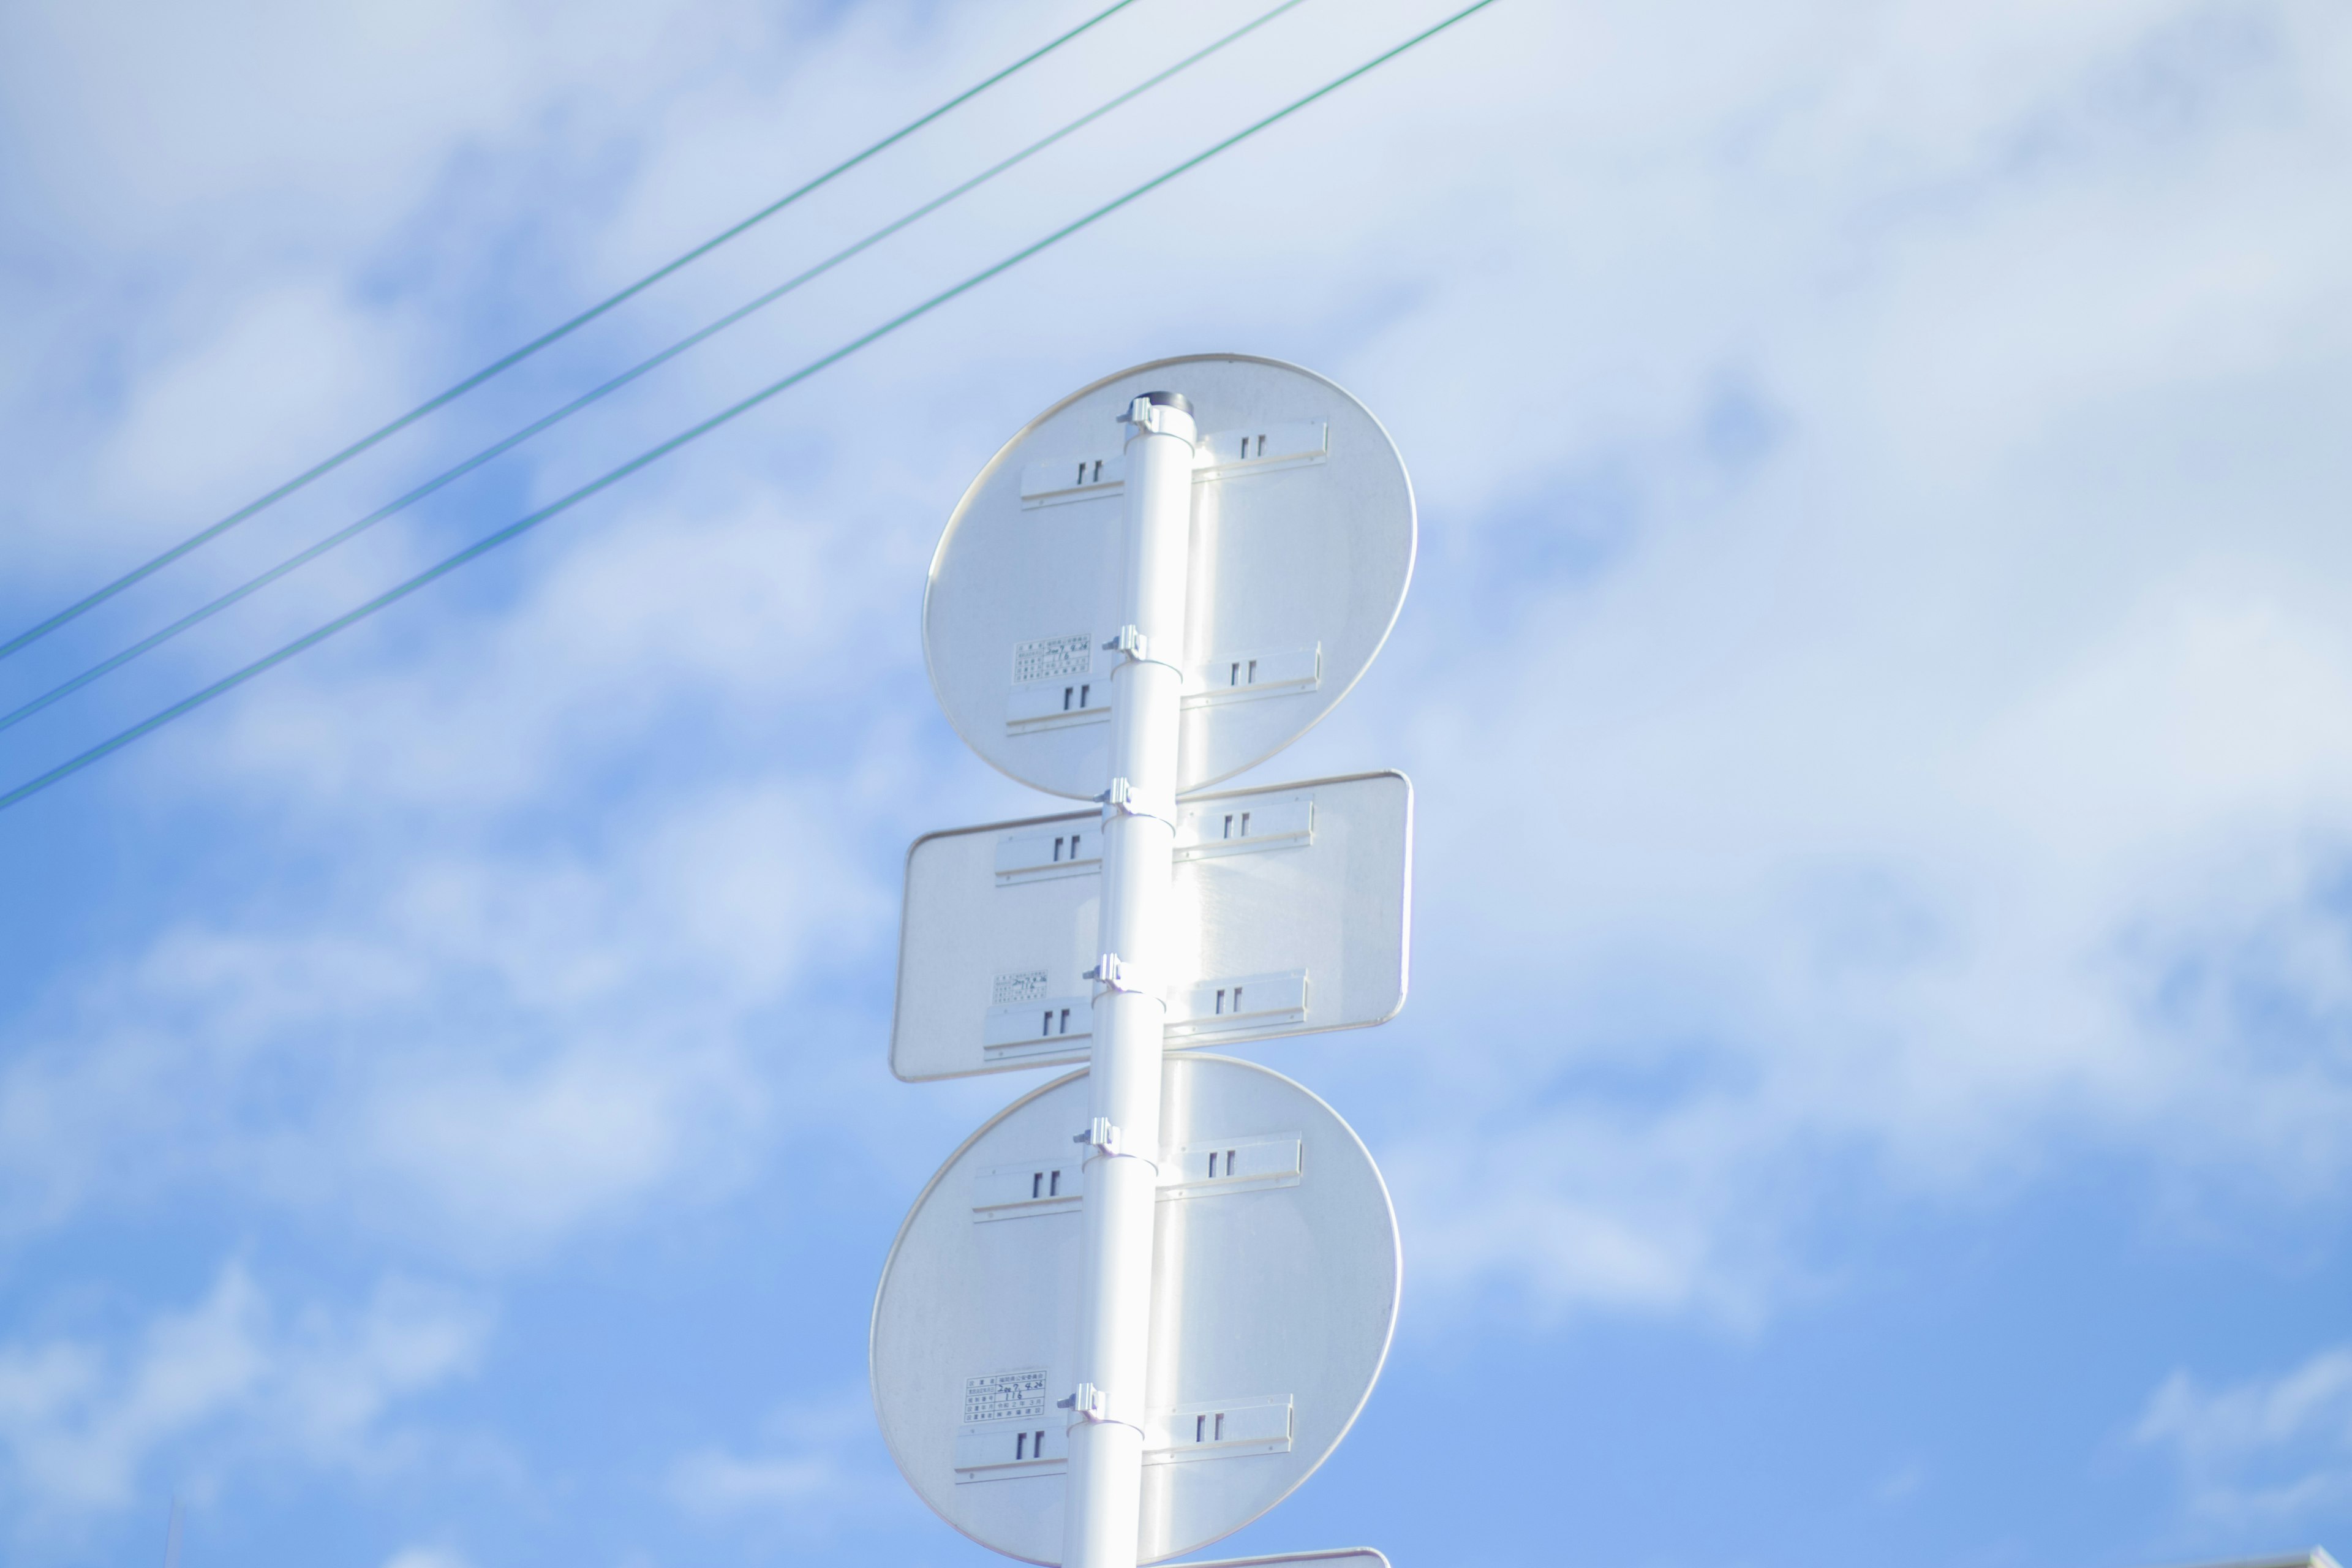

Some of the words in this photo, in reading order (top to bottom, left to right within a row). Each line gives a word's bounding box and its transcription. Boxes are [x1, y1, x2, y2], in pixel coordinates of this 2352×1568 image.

[999, 1373, 1043, 1383] 福岡県公安委員会
[1006, 1391, 1022, 1401] 116
